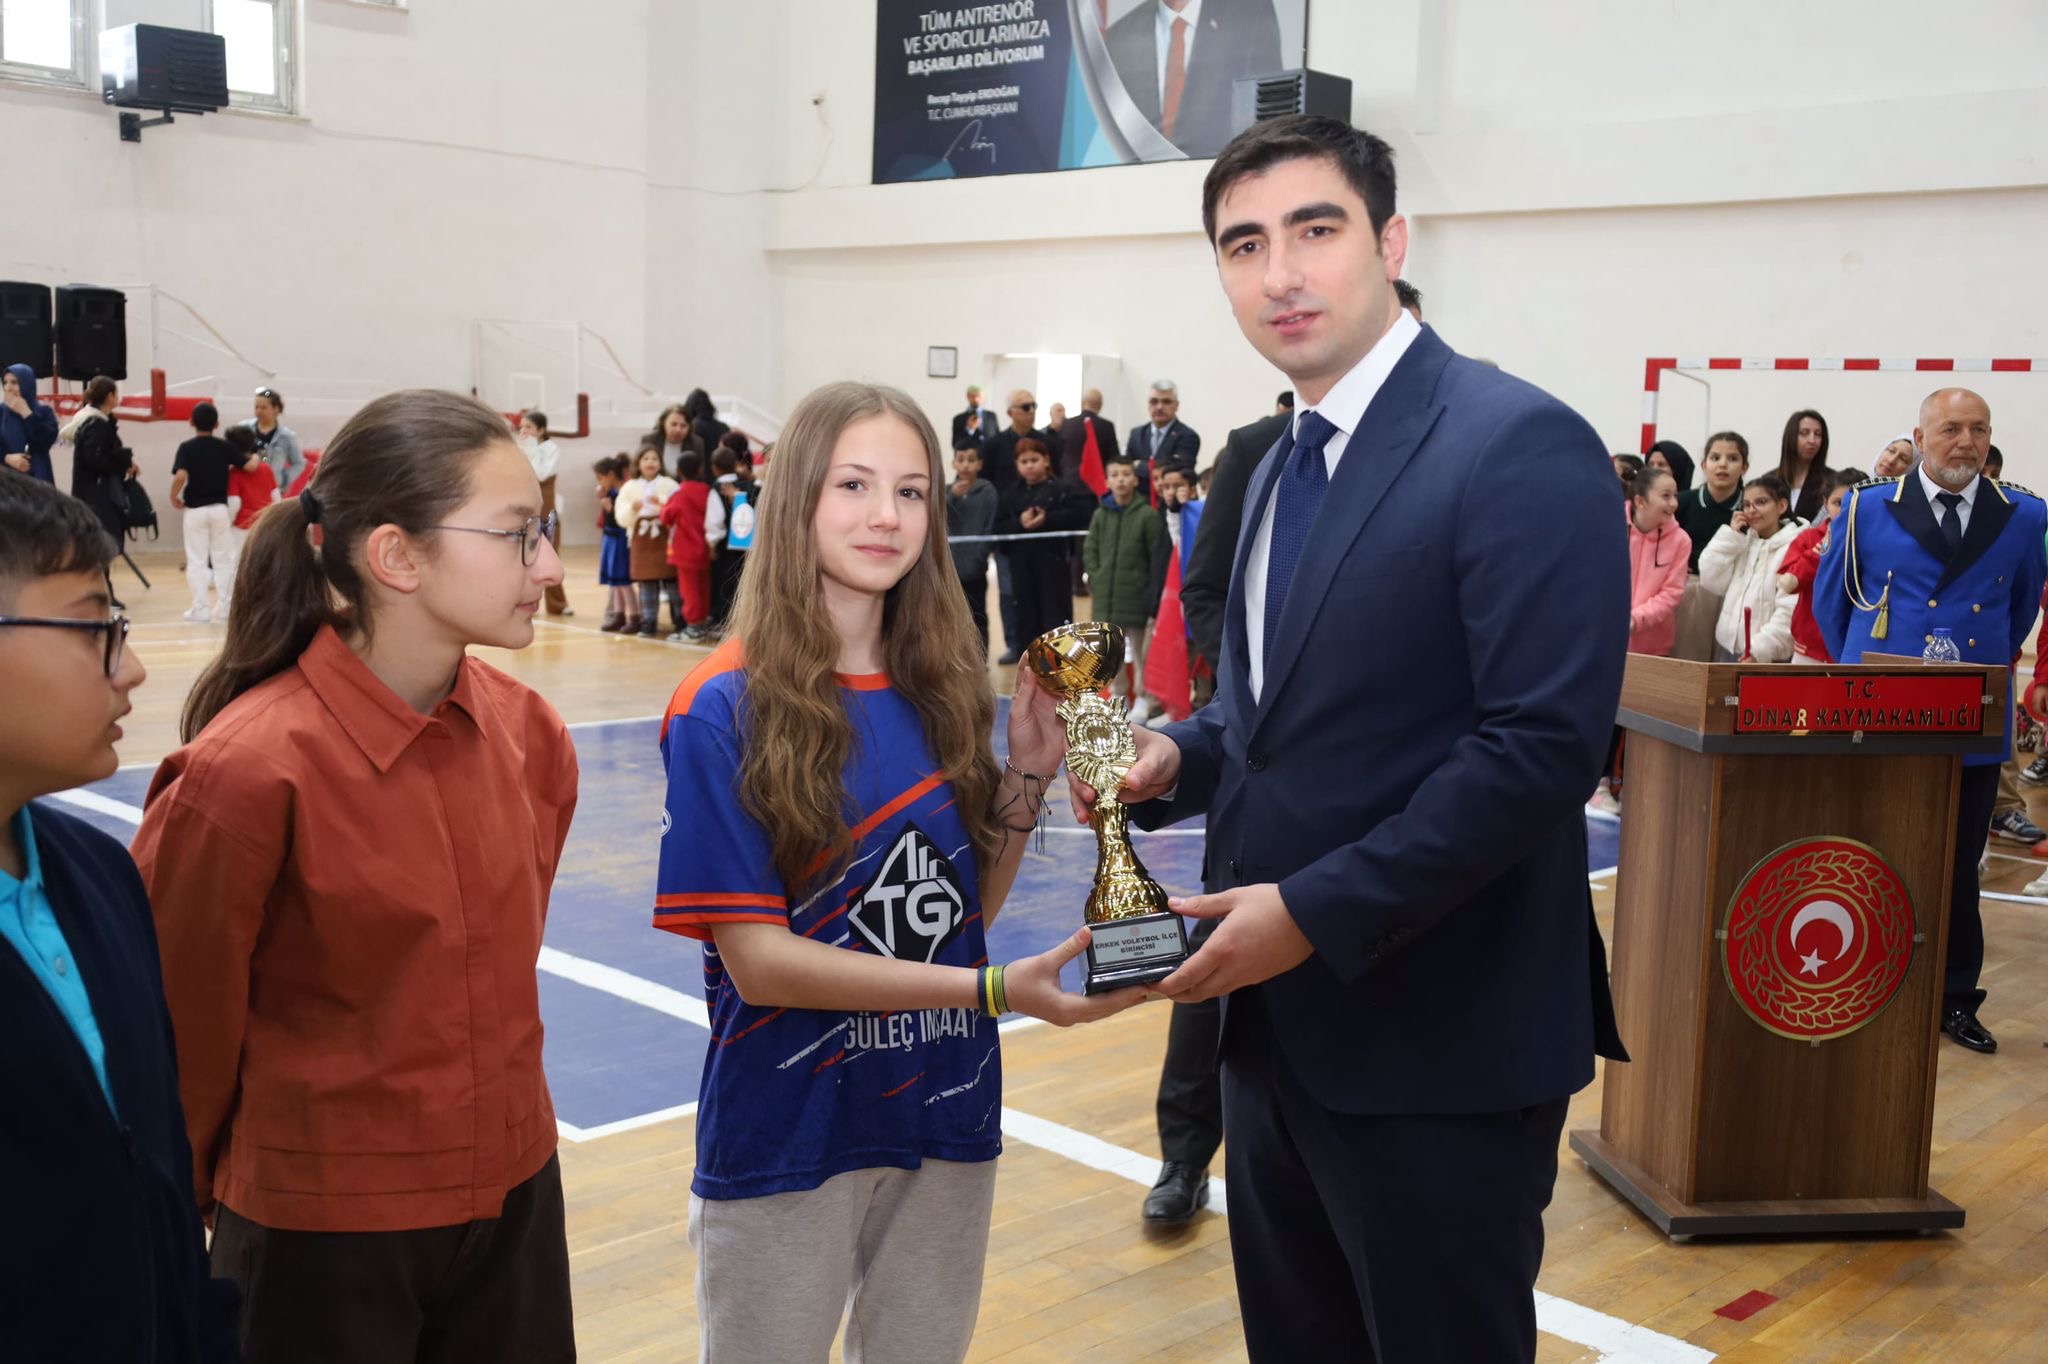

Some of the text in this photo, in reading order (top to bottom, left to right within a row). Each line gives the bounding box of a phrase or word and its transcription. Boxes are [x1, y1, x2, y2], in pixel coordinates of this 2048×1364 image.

[920, 10, 951, 32] TÜM
[904, 19, 1051, 55] VE SPORCULARIMIZA
[907, 45, 1045, 76] BAŞARILAR DİLİYORUM
[978, 85, 1020, 100] ERDOĞAN
[1844, 680, 1881, 699] T.C.
[1743, 703, 1977, 728] DİNAR KAYMAKAMLIĞI
[1095, 941, 1120, 950] ERKEK
[1121, 935, 1160, 946] VOLEYBOL
[844, 1011, 915, 1052] GÜLEÇ
